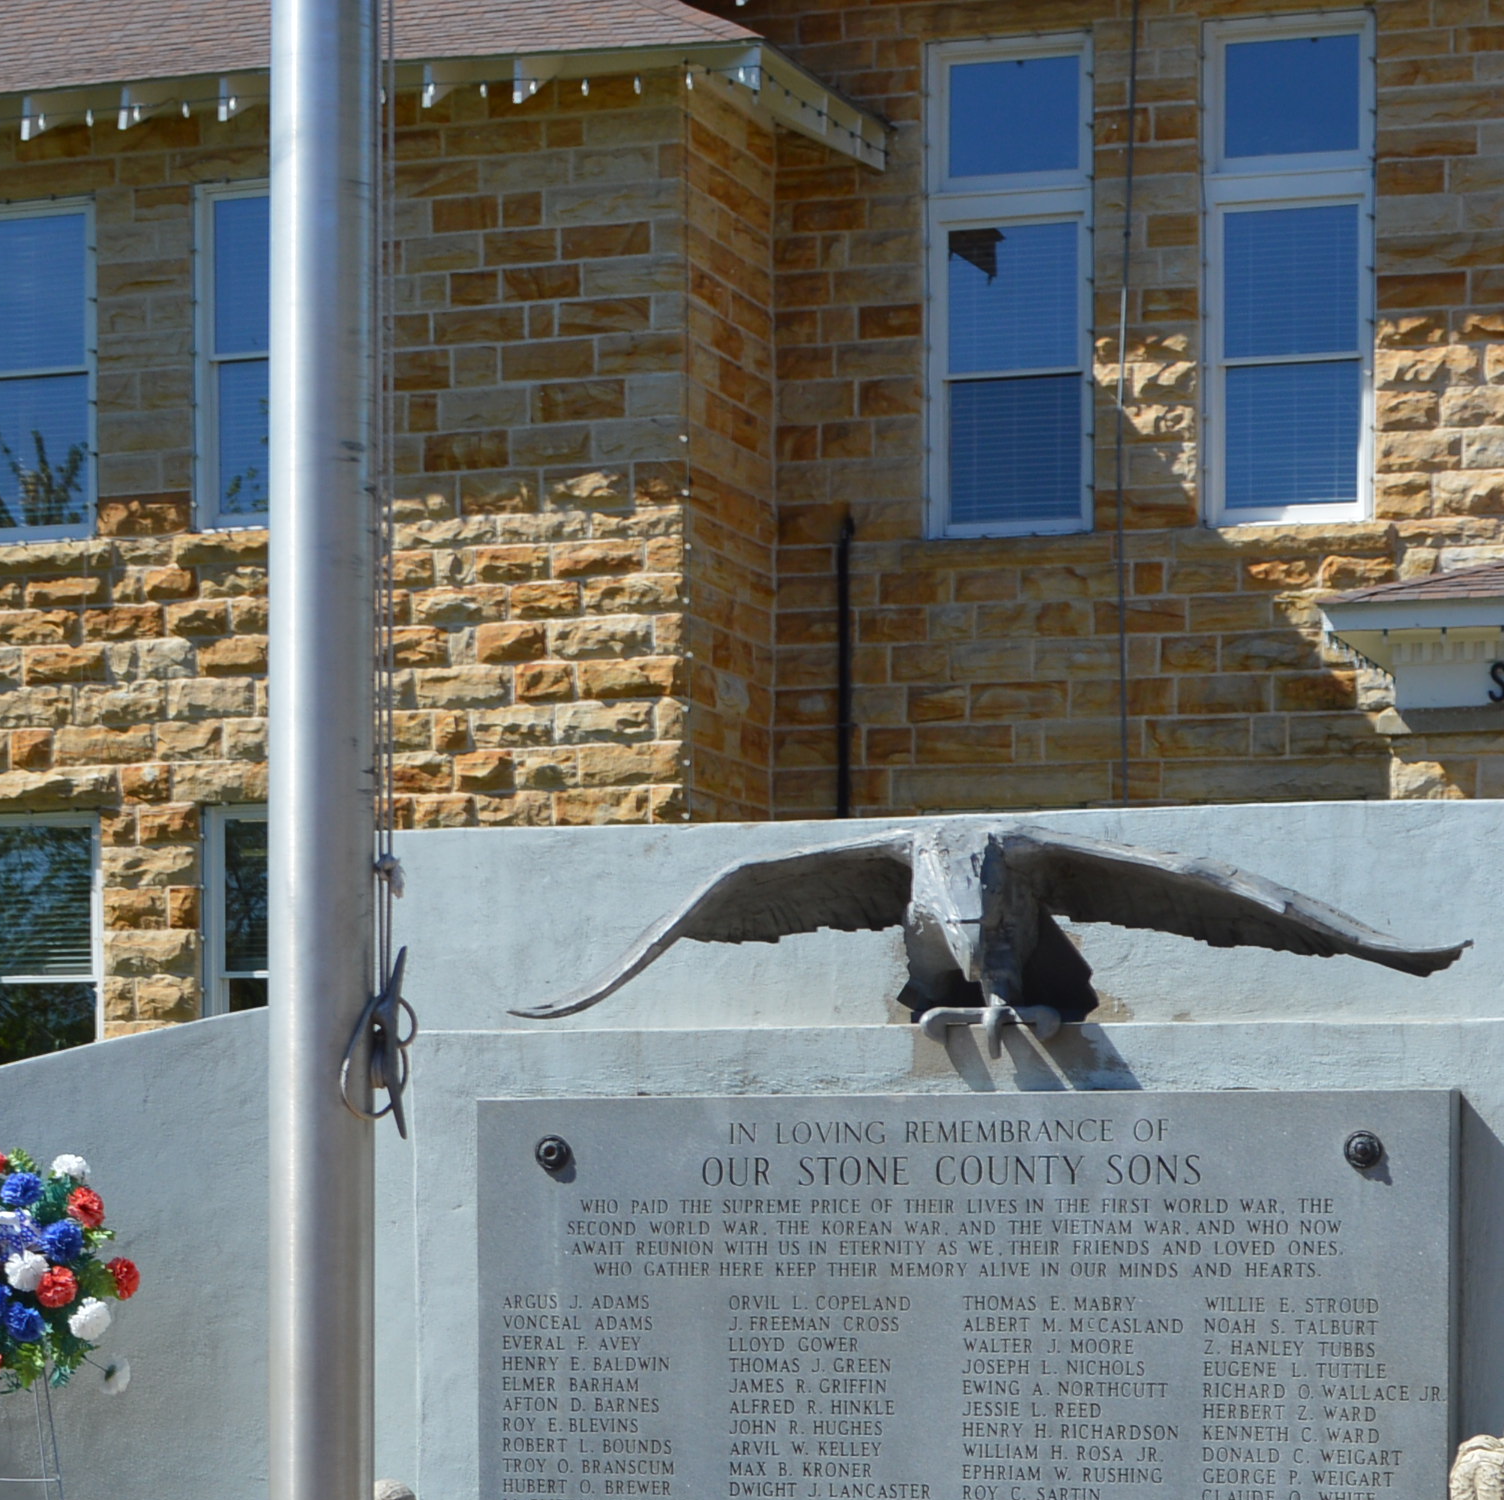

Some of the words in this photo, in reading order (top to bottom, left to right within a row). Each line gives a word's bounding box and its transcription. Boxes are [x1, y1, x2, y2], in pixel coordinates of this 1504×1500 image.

[730, 1123, 756, 1144] IN
[776, 1121, 885, 1144] LOVING
[905, 1118, 1113, 1143] REMEMBRANCE
[1133, 1119, 1168, 1142] OF
[702, 1157, 769, 1186] OUR
[798, 1156, 909, 1186] STONE
[935, 1155, 1085, 1185] COUNTY
[1106, 1154, 1201, 1185] SONS
[580, 1199, 618, 1213] WHO
[631, 1199, 668, 1214] PAID
[679, 1199, 712, 1213] THE
[722, 1199, 801, 1213] SUPREME
[811, 1199, 860, 1213] PRICE
[871, 1198, 893, 1213] OF
[904, 1199, 953, 1213] THEIR
[967, 1199, 1017, 1214] LIVES
[1024, 1198, 1044, 1213] IN
[1055, 1198, 1090, 1213] THE
[1102, 1198, 1150, 1213] FIRST
[1163, 1198, 1228, 1213] WORLD
[1298, 1197, 1333, 1213] THE
[567, 1220, 636, 1235] SECOND
[649, 1221, 710, 1235] WORLD
[776, 1220, 809, 1234] THE
[822, 1220, 891, 1235] KOREAN
[958, 1220, 995, 1235] AND
[1008, 1220, 1041, 1235] THE
[1051, 1219, 1131, 1234] VIETNAM
[1197, 1219, 1235, 1234] AND
[1246, 1220, 1288, 1234] WHO
[1300, 1220, 1342, 1235] NOW
[571, 1241, 624, 1255] AWAIT
[636, 1240, 713, 1255] REUNION
[724, 1241, 767, 1255] WITH
[778, 1241, 800, 1255] US
[809, 1241, 826, 1255] IN
[839, 1240, 925, 1255] ETERNITY
[937, 1240, 957, 1255] AS
[1011, 1240, 1059, 1255] THEIR
[1073, 1240, 1149, 1255] FRIENDS
[1163, 1240, 1201, 1255] AND
[1214, 1240, 1275, 1255] LOVED
[1288, 1240, 1343, 1255] ONES.
[594, 1261, 632, 1276] WHO
[644, 1262, 709, 1276] GATHER
[719, 1262, 763, 1276] HERE
[775, 1262, 816, 1277] KEEP
[827, 1262, 876, 1277] THEIR
[890, 1262, 967, 1277] MEMORY
[979, 1261, 1030, 1277] ALIVE
[1042, 1262, 1059, 1277] IN
[1070, 1262, 1106, 1277] OUR
[1119, 1262, 1178, 1278] MINDS
[1191, 1262, 1231, 1277] AND
[1245, 1262, 1321, 1278] HEARTS.
[504, 1294, 557, 1309] ARGUS
[569, 1295, 582, 1309] J.
[592, 1294, 649, 1309] ADAMS
[729, 1295, 779, 1310] ORVIL
[793, 1295, 808, 1309] L.
[816, 1295, 910, 1311] COPELAND
[962, 1295, 1036, 1311] THOMAS
[1050, 1295, 1065, 1310] E.
[1074, 1296, 1136, 1311] MABRY
[1205, 1297, 1264, 1312] WILLIE
[1279, 1297, 1295, 1312] E.
[1305, 1298, 1379, 1313] STROUD
[503, 1315, 581, 1330] VONCEAL
[595, 1316, 652, 1330] ADAMS
[728, 1337, 785, 1352] LLOYD
[798, 1337, 857, 1352] GOWER
[502, 1356, 558, 1371] HENRY
[570, 1356, 585, 1371] E.
[593, 1356, 669, 1371] BALDWIN
[962, 1359, 1029, 1374] JOSEPH
[1041, 1360, 1057, 1374] L.
[1066, 1360, 1144, 1376] NICHOLS
[1203, 1361, 1276, 1377] EUGENE
[1292, 1363, 1306, 1377] L.
[1315, 1363, 1386, 1378] TUTTLE
[502, 1376, 555, 1391] ELMER
[569, 1377, 638, 1392] BARHAM
[729, 1378, 784, 1393] JAMES
[796, 1379, 811, 1393] R.
[819, 1378, 886, 1394] GRIFFIN
[962, 1380, 1020, 1395] EWING
[1032, 1382, 1049, 1395] A.
[1058, 1381, 1168, 1398] NORTHCUTT
[503, 1437, 567, 1452] ROBERT
[580, 1439, 594, 1452] L.
[603, 1439, 672, 1454] BOUNDS
[1202, 1447, 1279, 1463] DONALD
[1293, 1448, 1309, 1463] C.
[1320, 1449, 1403, 1466] WEIGART
[503, 1458, 546, 1472] TROY
[557, 1459, 573, 1473] O.
[582, 1459, 674, 1474] BRANSCUM
[729, 1481, 797, 1497] DWIGHT
[808, 1483, 821, 1497] J.
[829, 1483, 930, 1499] LANCASTER
